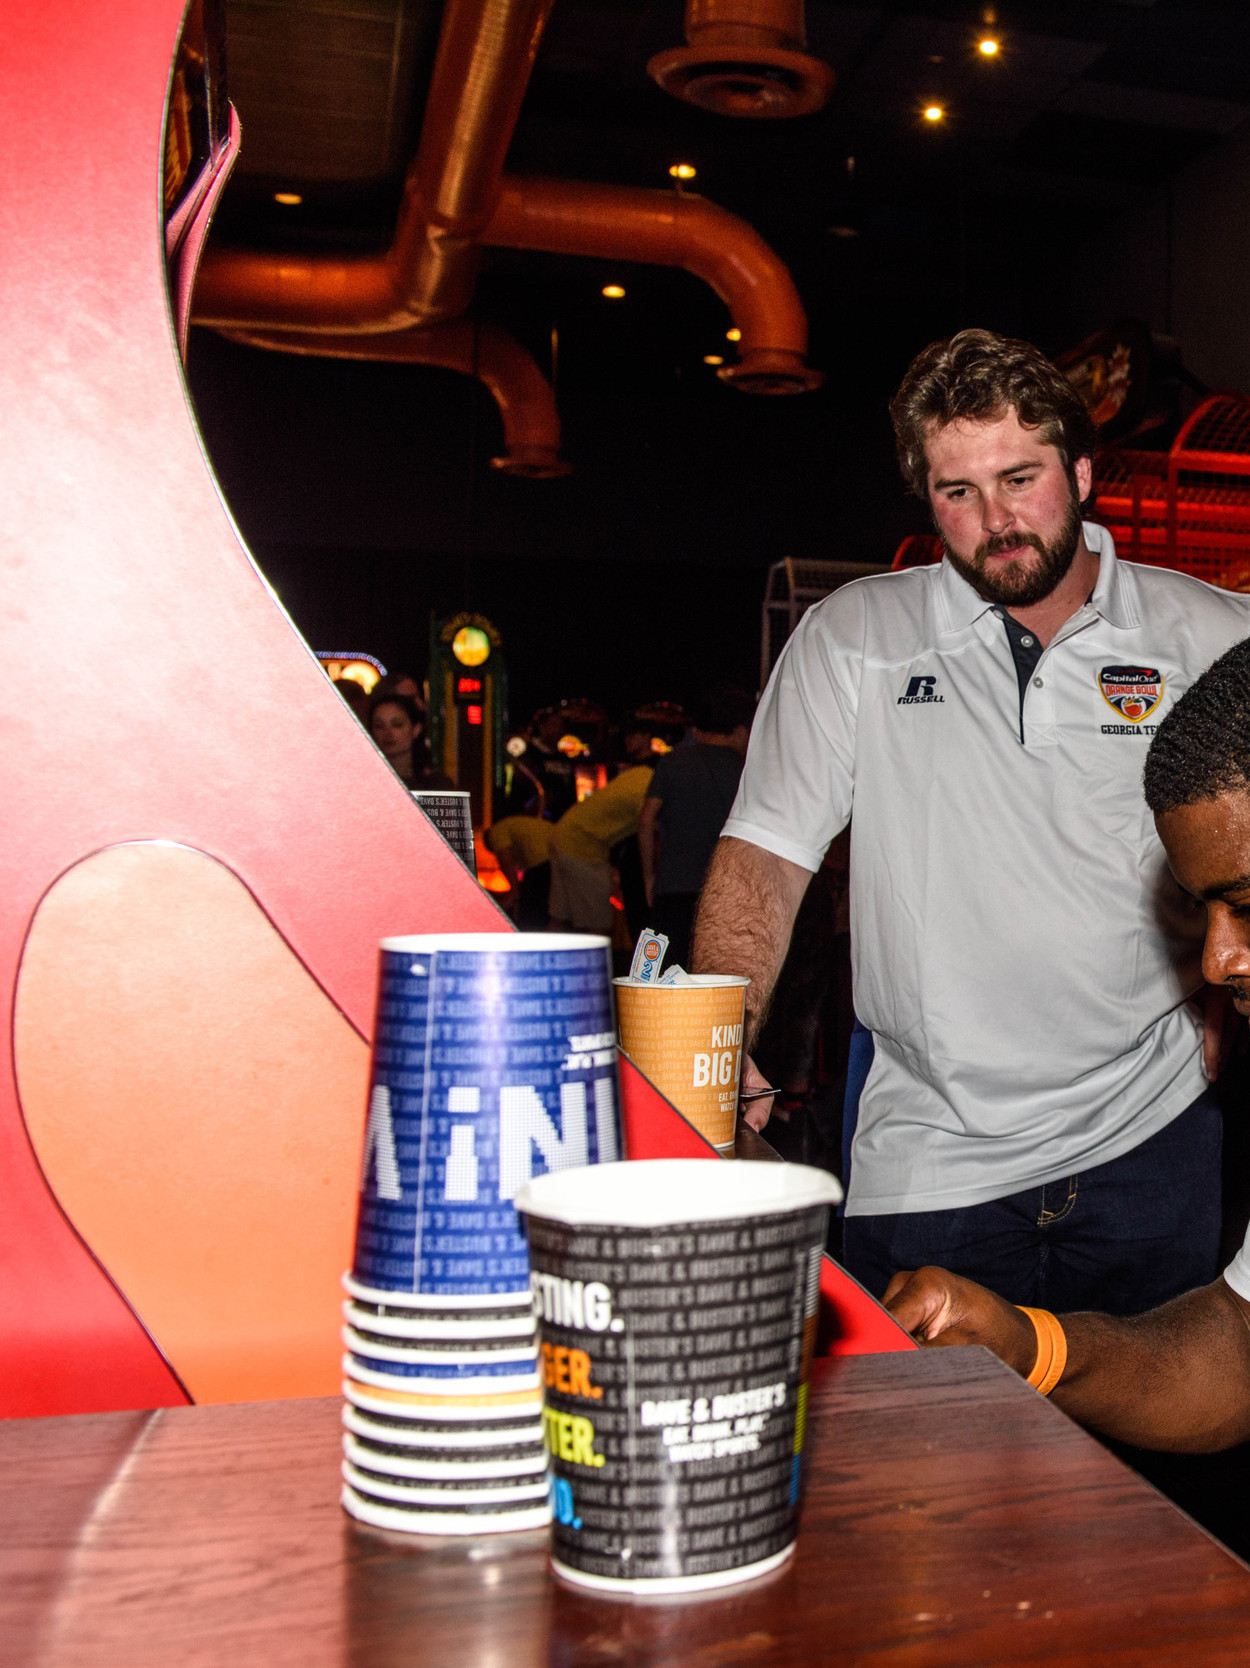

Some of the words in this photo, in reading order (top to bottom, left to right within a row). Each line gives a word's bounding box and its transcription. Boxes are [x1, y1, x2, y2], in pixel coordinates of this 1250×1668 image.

[897, 695, 946, 705] RUSSELL
[1105, 684, 1135, 697] ORANGE
[1135, 685, 1158, 697] BOWL
[1101, 725, 1143, 735] GEORGIA
[1143, 725, 1158, 735] TE
[641, 960, 653, 977] 2
[693, 1051, 732, 1087] BIG
[688, 1253, 758, 1281] BUSTER'S
[688, 1302, 757, 1331] BUSTER'S
[688, 1351, 755, 1380] BUSTER'S
[641, 1398, 692, 1427] DAVE
[692, 1396, 711, 1423] &
[711, 1381, 786, 1421] BUSTER'S
